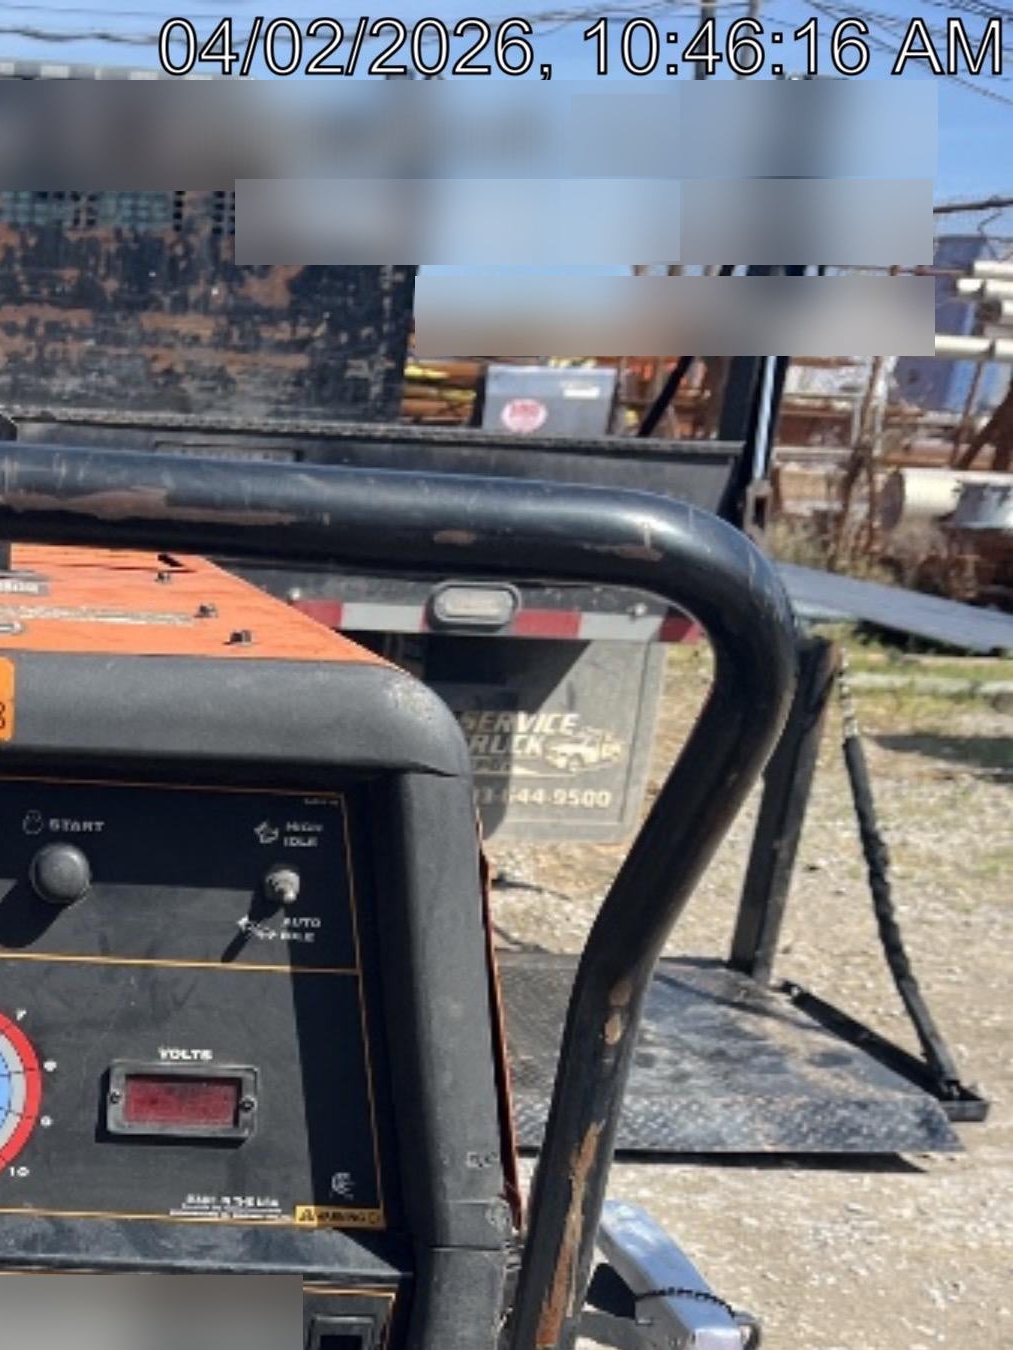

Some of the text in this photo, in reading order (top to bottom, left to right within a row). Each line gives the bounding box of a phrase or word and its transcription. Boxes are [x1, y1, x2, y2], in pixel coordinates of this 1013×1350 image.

[469, 734, 546, 757] RUCK
[49, 819, 105, 832] START
[283, 917, 321, 928] AUTO
[158, 1047, 213, 1061] VOLTS
